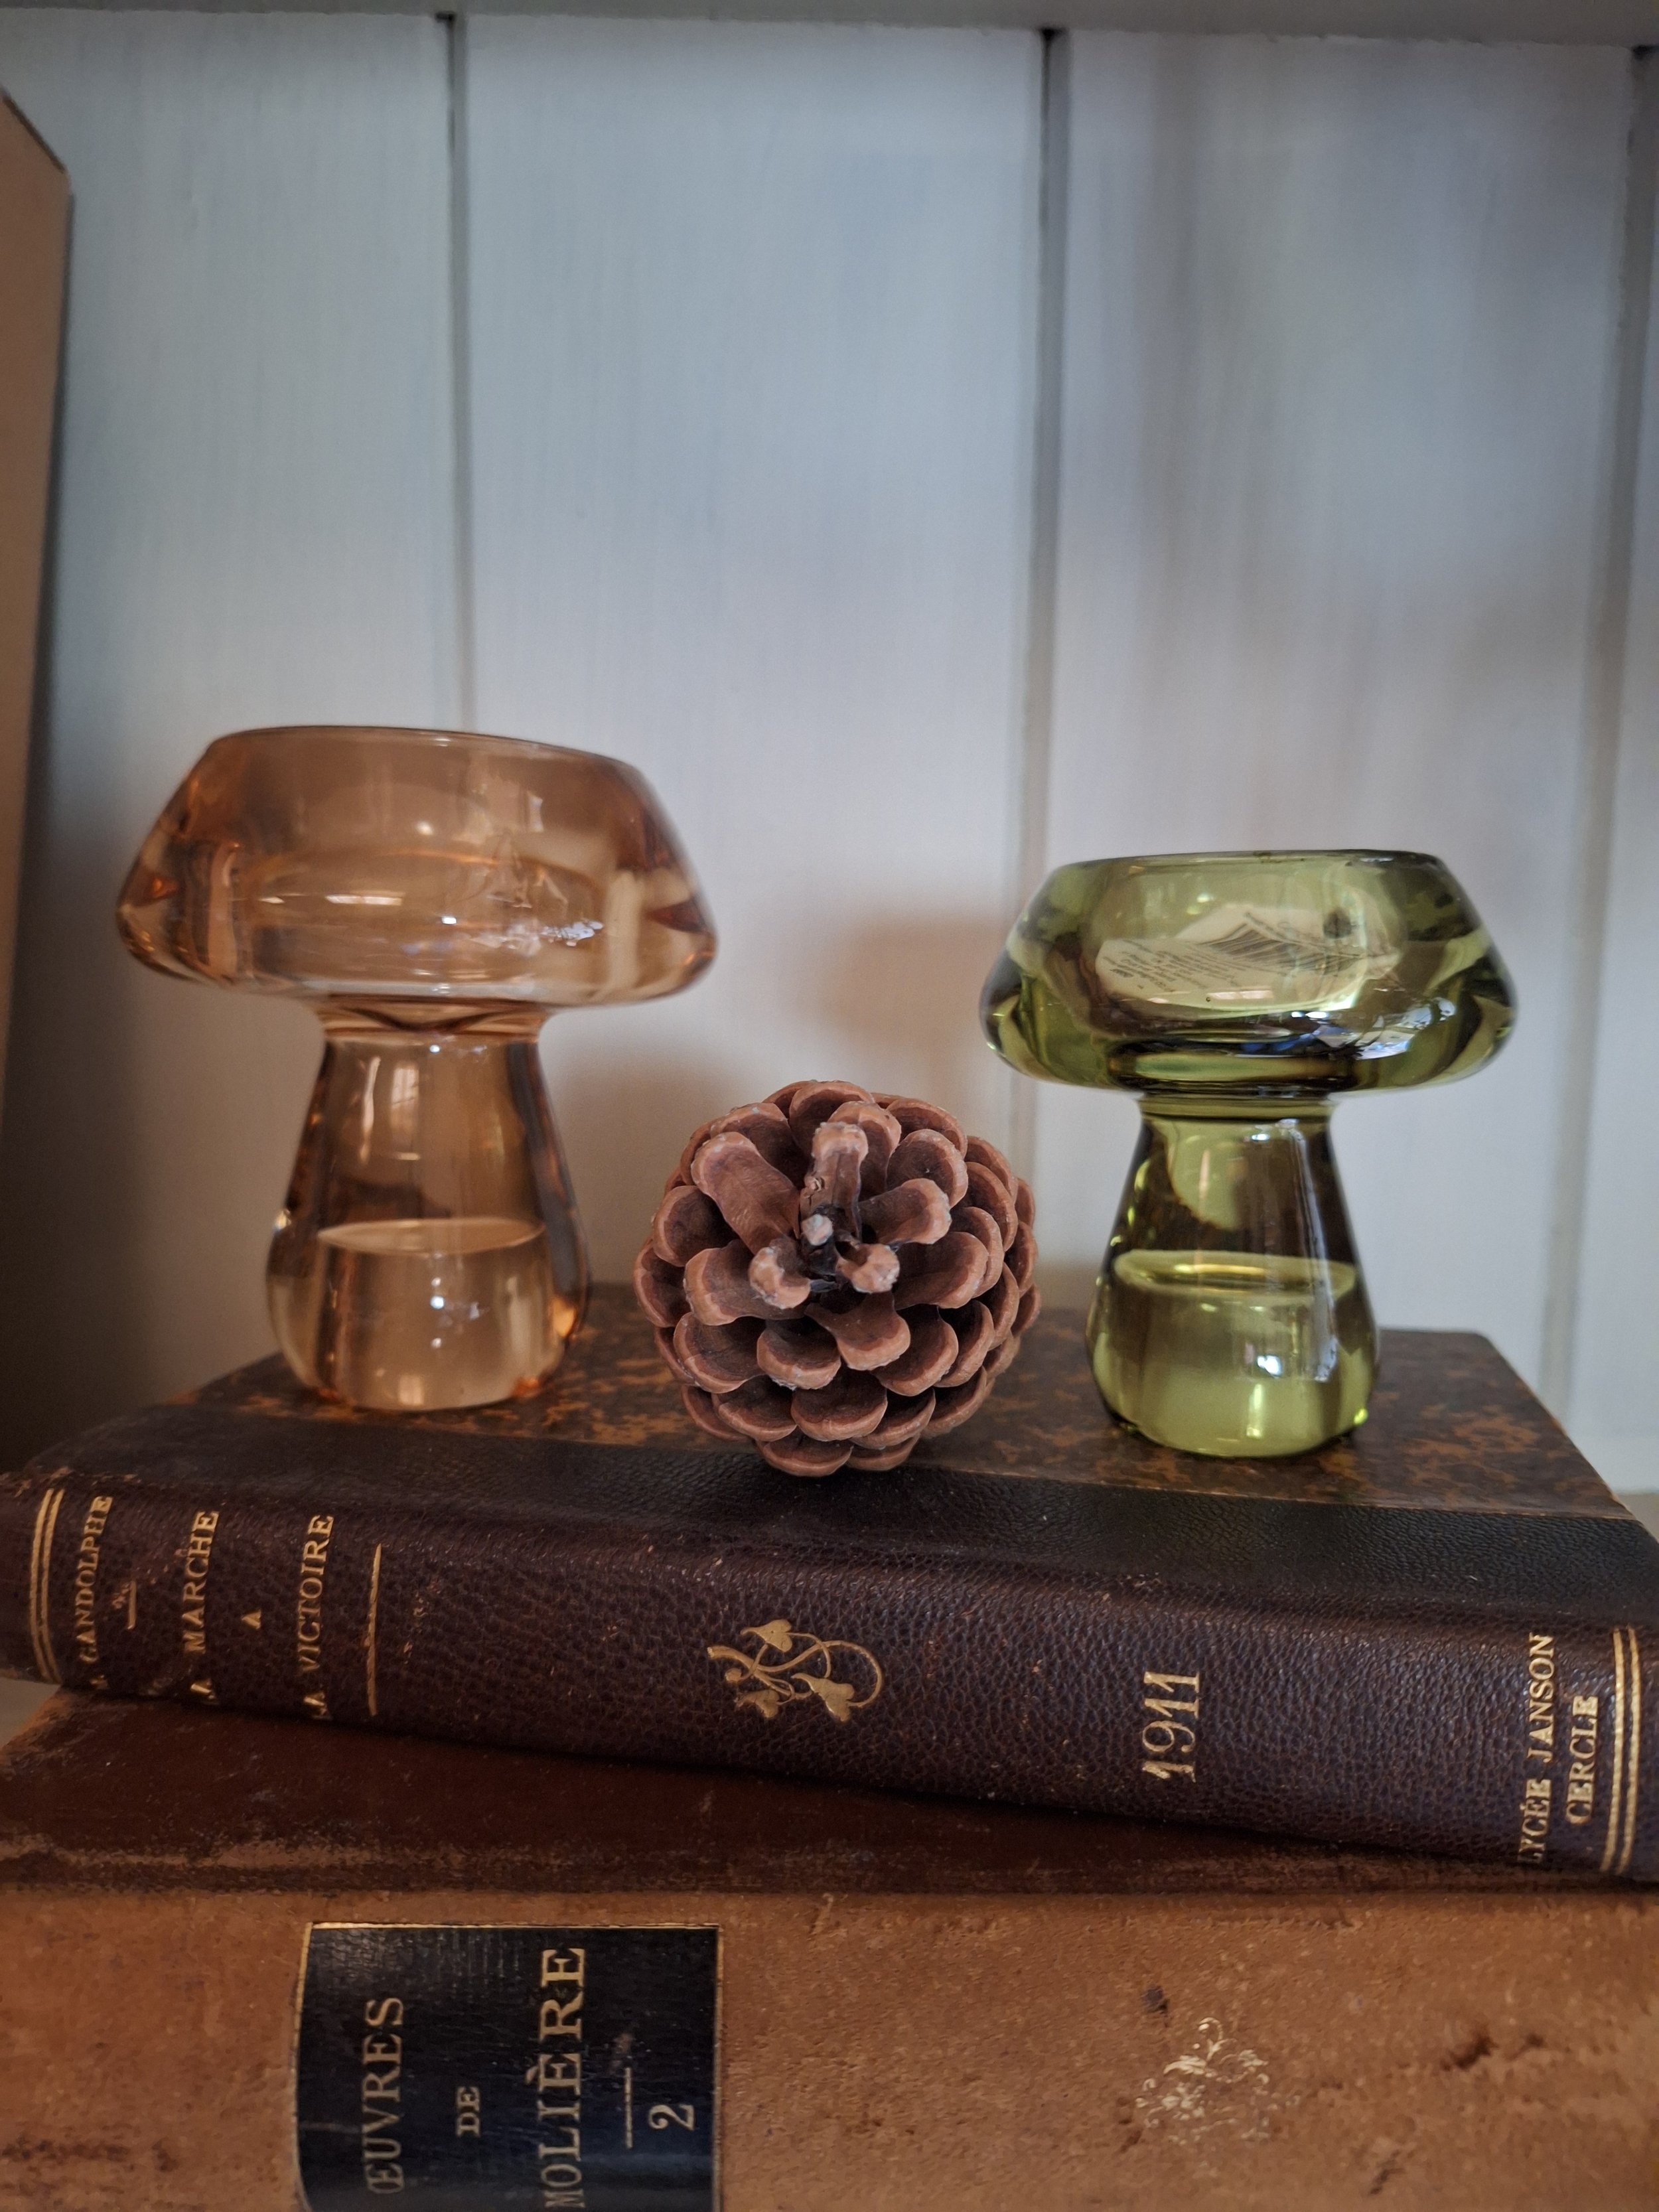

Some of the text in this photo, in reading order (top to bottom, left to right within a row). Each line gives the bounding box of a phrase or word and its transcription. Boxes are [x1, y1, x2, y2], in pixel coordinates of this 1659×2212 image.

[75, 1496, 113, 1664] GANDOLPHE
[182, 1511, 219, 1655] MARCHE
[242, 1609, 262, 1630] A
[298, 1514, 334, 1672] VICTOIRE
[1142, 1671, 1200, 1783] 1911
[1526, 1632, 1555, 1763] JANSON
[1565, 1694, 1599, 1825] CERCLE
[361, 1997, 404, 2195] ŒUVRES
[456, 2085, 481, 2138] DE
[525, 1947, 586, 2209] MOLIÈRE
[647, 2103, 695, 2131] 2
